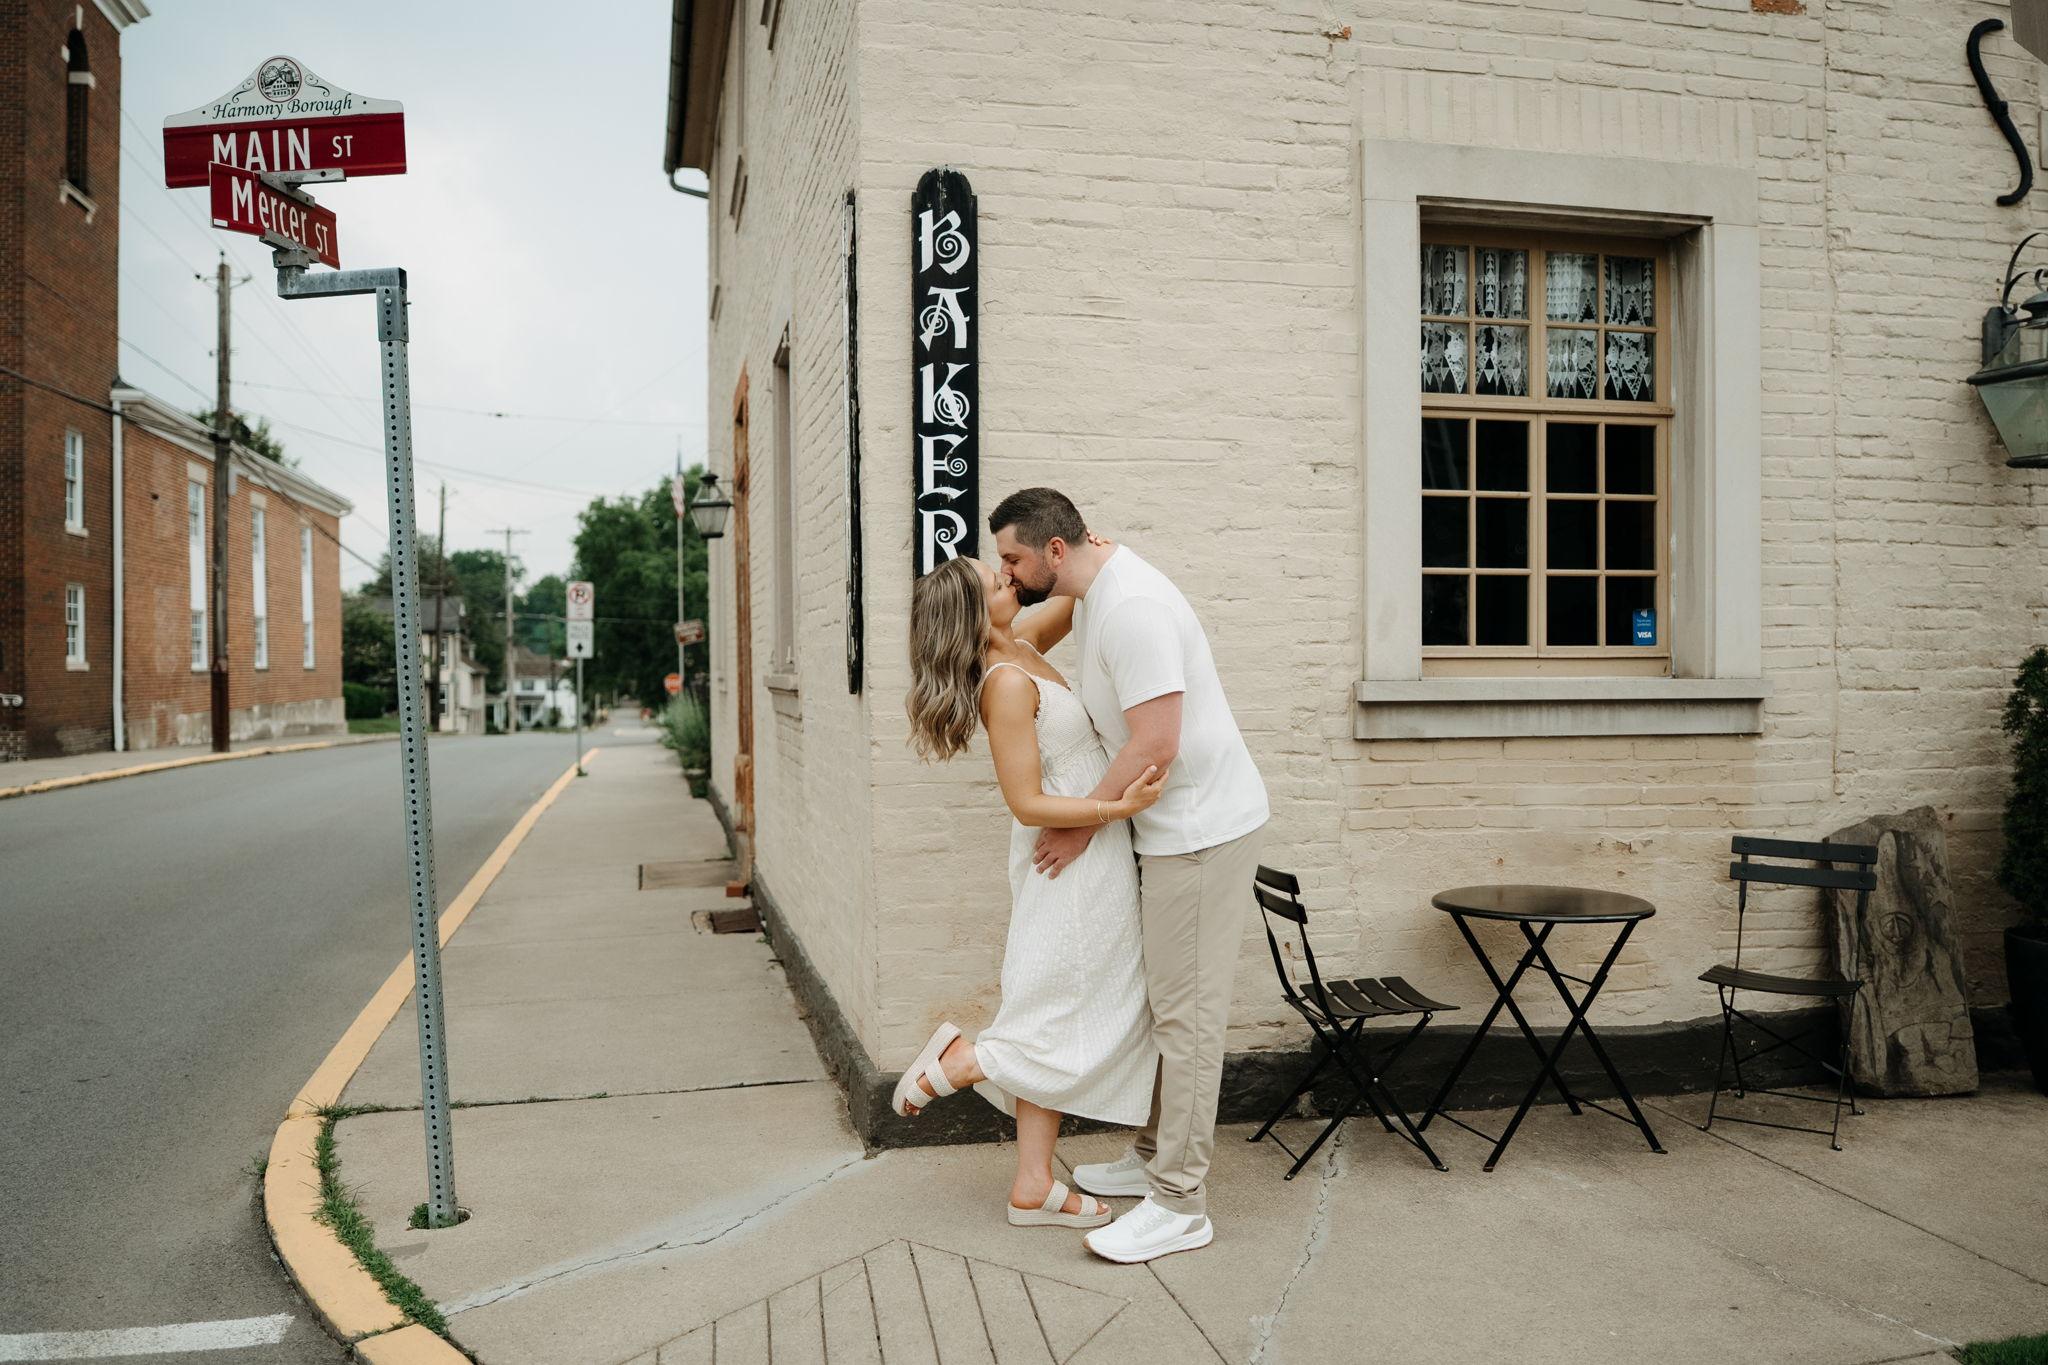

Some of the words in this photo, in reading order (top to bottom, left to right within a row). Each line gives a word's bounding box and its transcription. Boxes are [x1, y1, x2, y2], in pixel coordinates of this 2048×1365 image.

[212, 102, 283, 120] Harmony
[287, 93, 352, 116] Borough
[212, 127, 311, 173] MAIN
[332, 135, 353, 158] ST
[231, 176, 309, 246] Mercer
[315, 222, 329, 256] ST
[918, 209, 971, 576] BAKER
[1637, 631, 1652, 639] VISA
